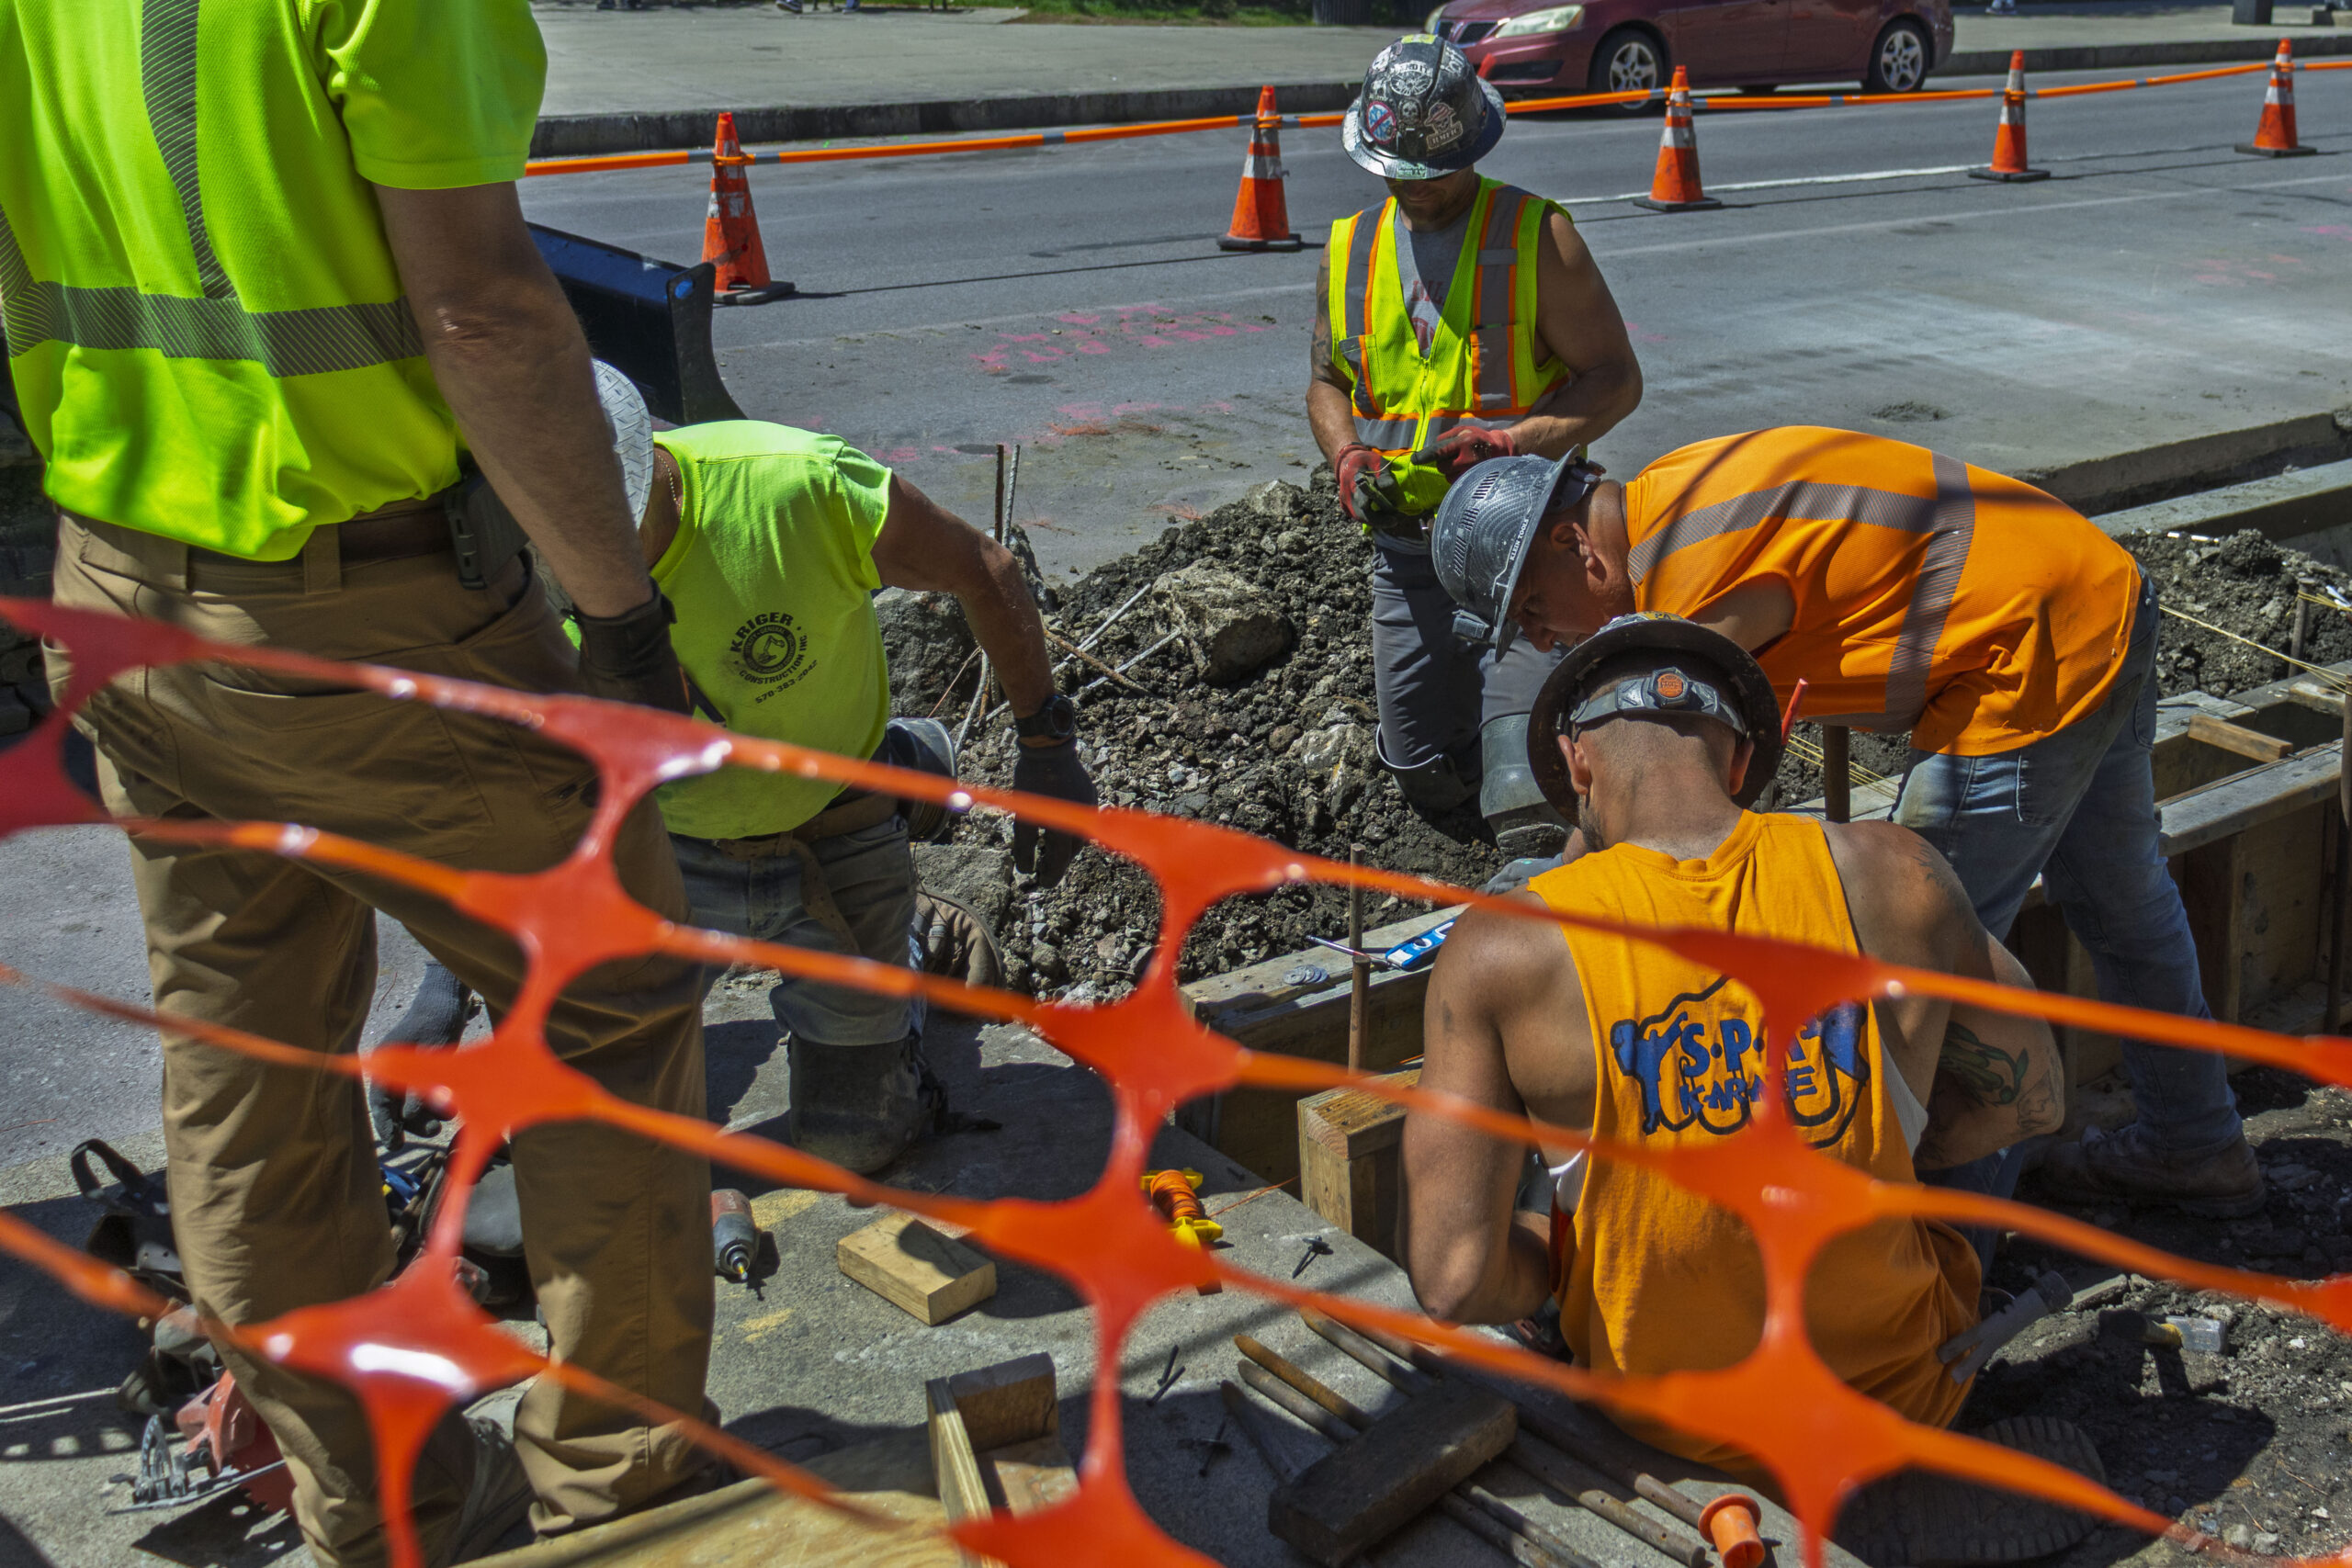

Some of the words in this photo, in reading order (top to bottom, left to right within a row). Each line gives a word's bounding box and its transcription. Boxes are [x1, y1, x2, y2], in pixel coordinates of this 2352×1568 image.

[1510, 540, 1521, 560] KLEIN
[729, 612, 794, 653] KRIGER
[739, 653, 805, 684] CONSTRUCTION
[799, 635, 808, 651] INC
[1679, 1066, 1818, 1115] KARAE
